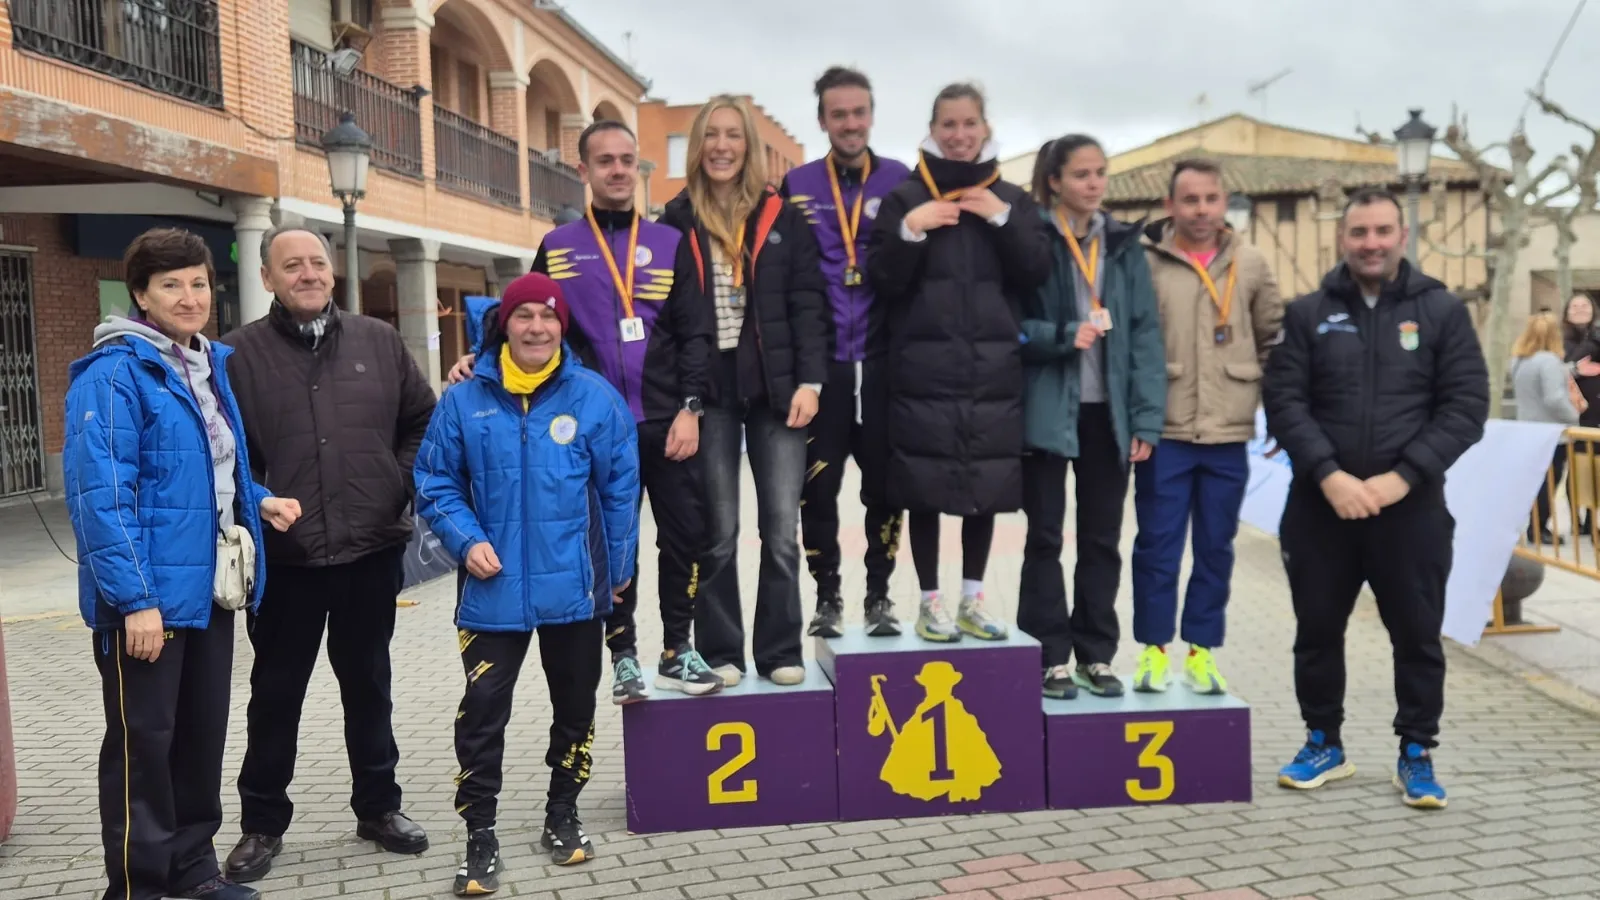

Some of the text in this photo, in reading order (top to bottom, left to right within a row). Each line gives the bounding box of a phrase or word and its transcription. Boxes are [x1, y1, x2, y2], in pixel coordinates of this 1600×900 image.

[706, 722, 758, 804] 2
[921, 700, 955, 781] 1
[1124, 721, 1175, 801] 3
